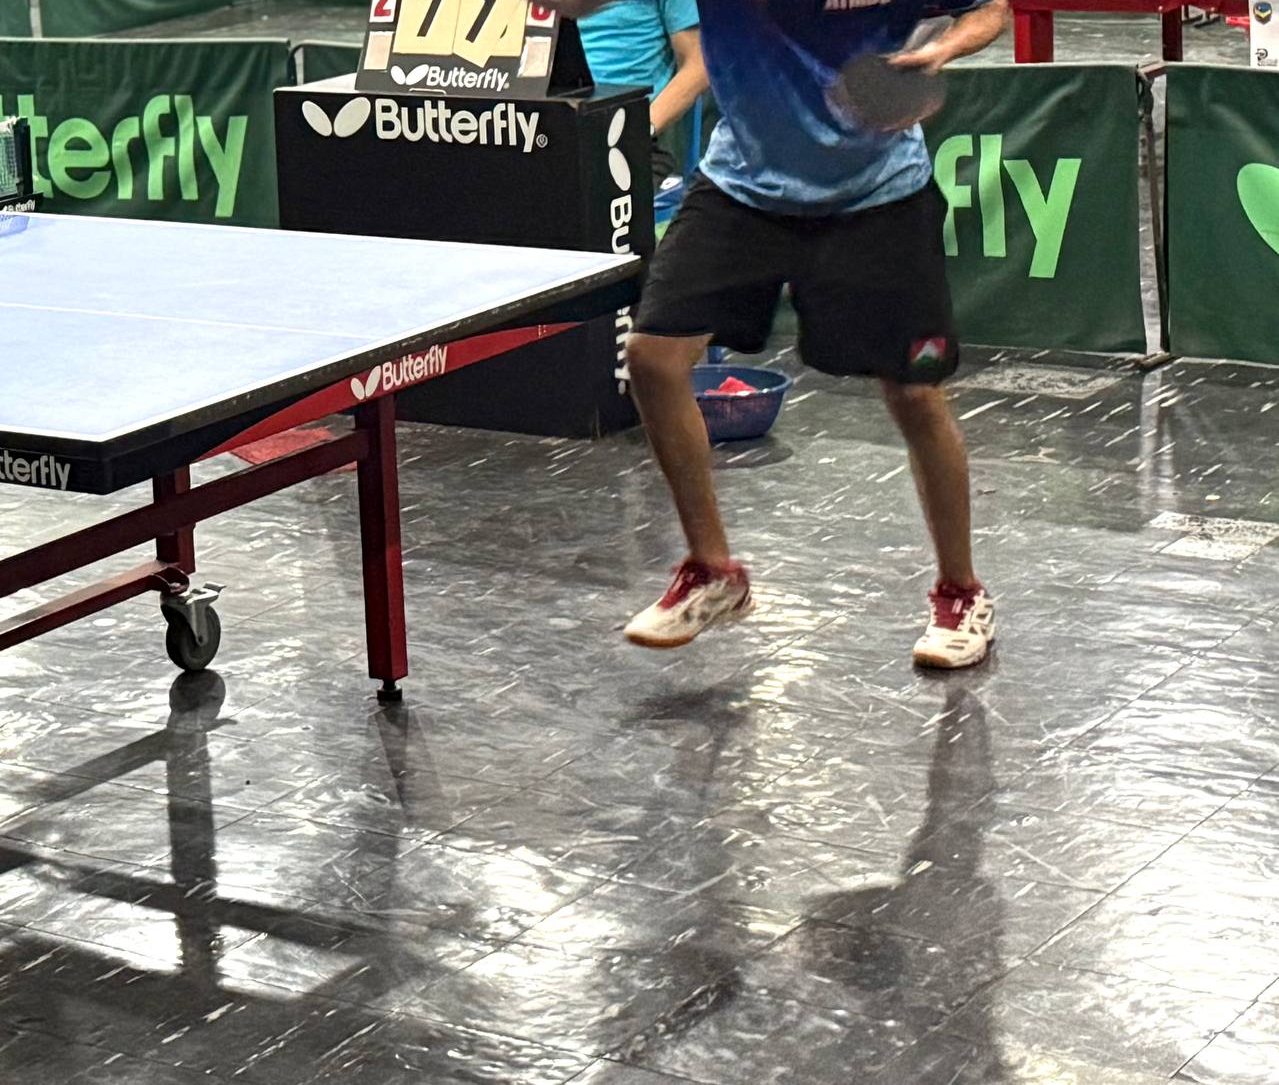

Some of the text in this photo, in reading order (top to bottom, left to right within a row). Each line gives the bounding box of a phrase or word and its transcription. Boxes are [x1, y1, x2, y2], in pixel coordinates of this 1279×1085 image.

[426, 65, 508, 92] Butterfly
[375, 98, 540, 153] Butterfly
[382, 344, 448, 391] Butterfly
